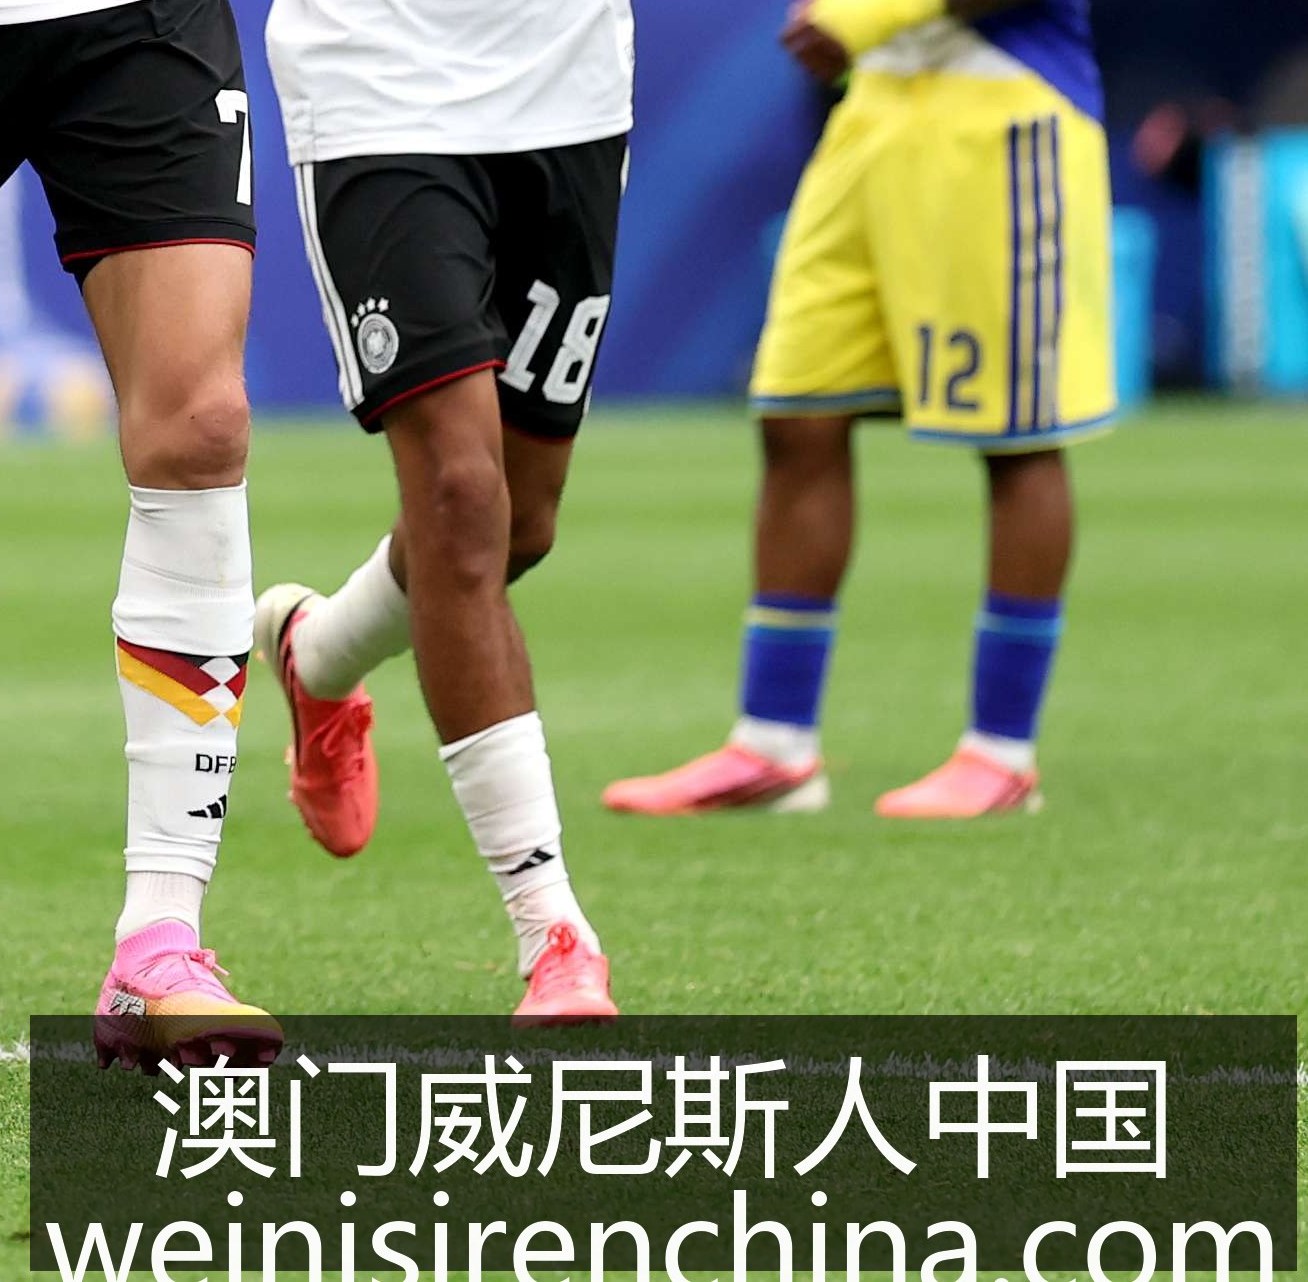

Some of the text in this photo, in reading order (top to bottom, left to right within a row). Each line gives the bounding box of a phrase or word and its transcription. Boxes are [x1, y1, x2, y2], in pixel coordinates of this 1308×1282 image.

[214, 89, 252, 206] 7
[498, 279, 611, 405] 18
[913, 325, 981, 411] 12
